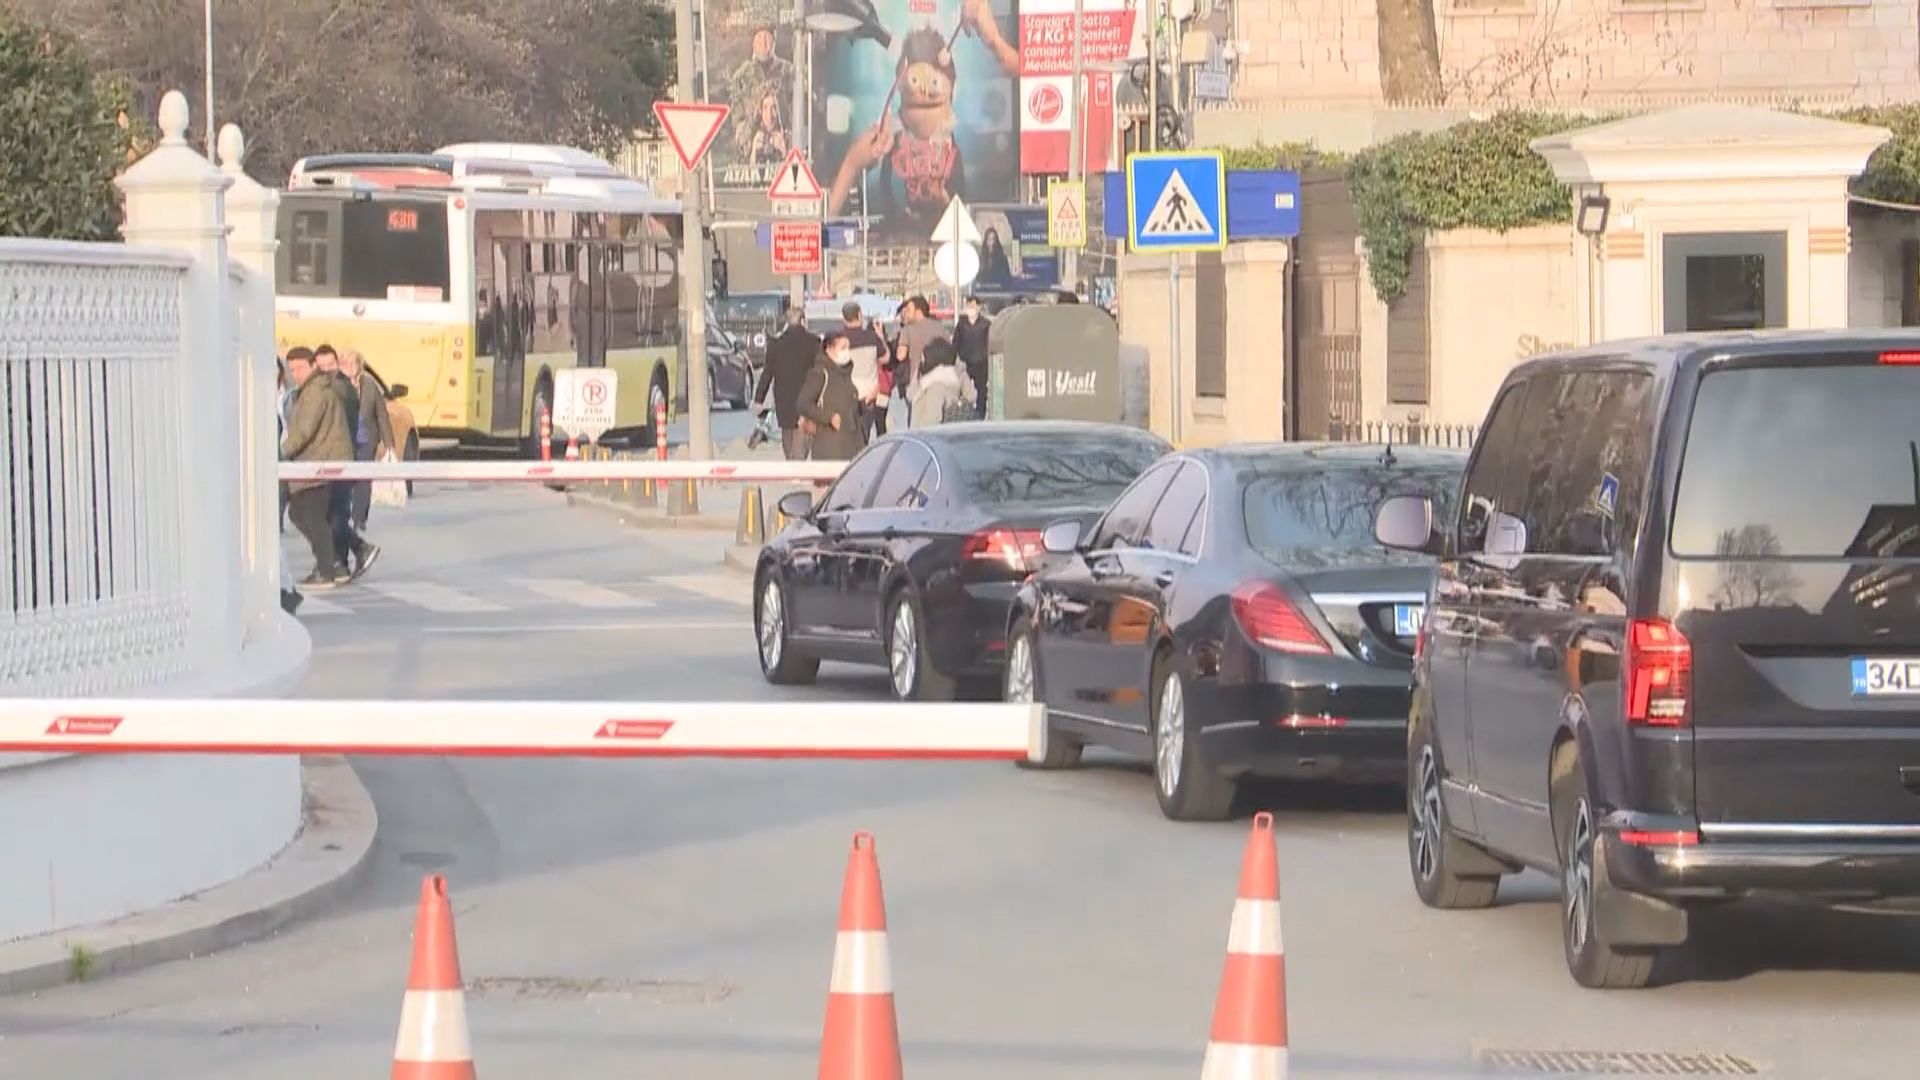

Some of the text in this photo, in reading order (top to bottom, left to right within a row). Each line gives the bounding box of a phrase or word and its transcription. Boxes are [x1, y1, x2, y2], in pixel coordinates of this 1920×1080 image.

[1024, 14, 1071, 30] Standart
[1026, 29, 1042, 44] 14
[1044, 27, 1065, 43] KG
